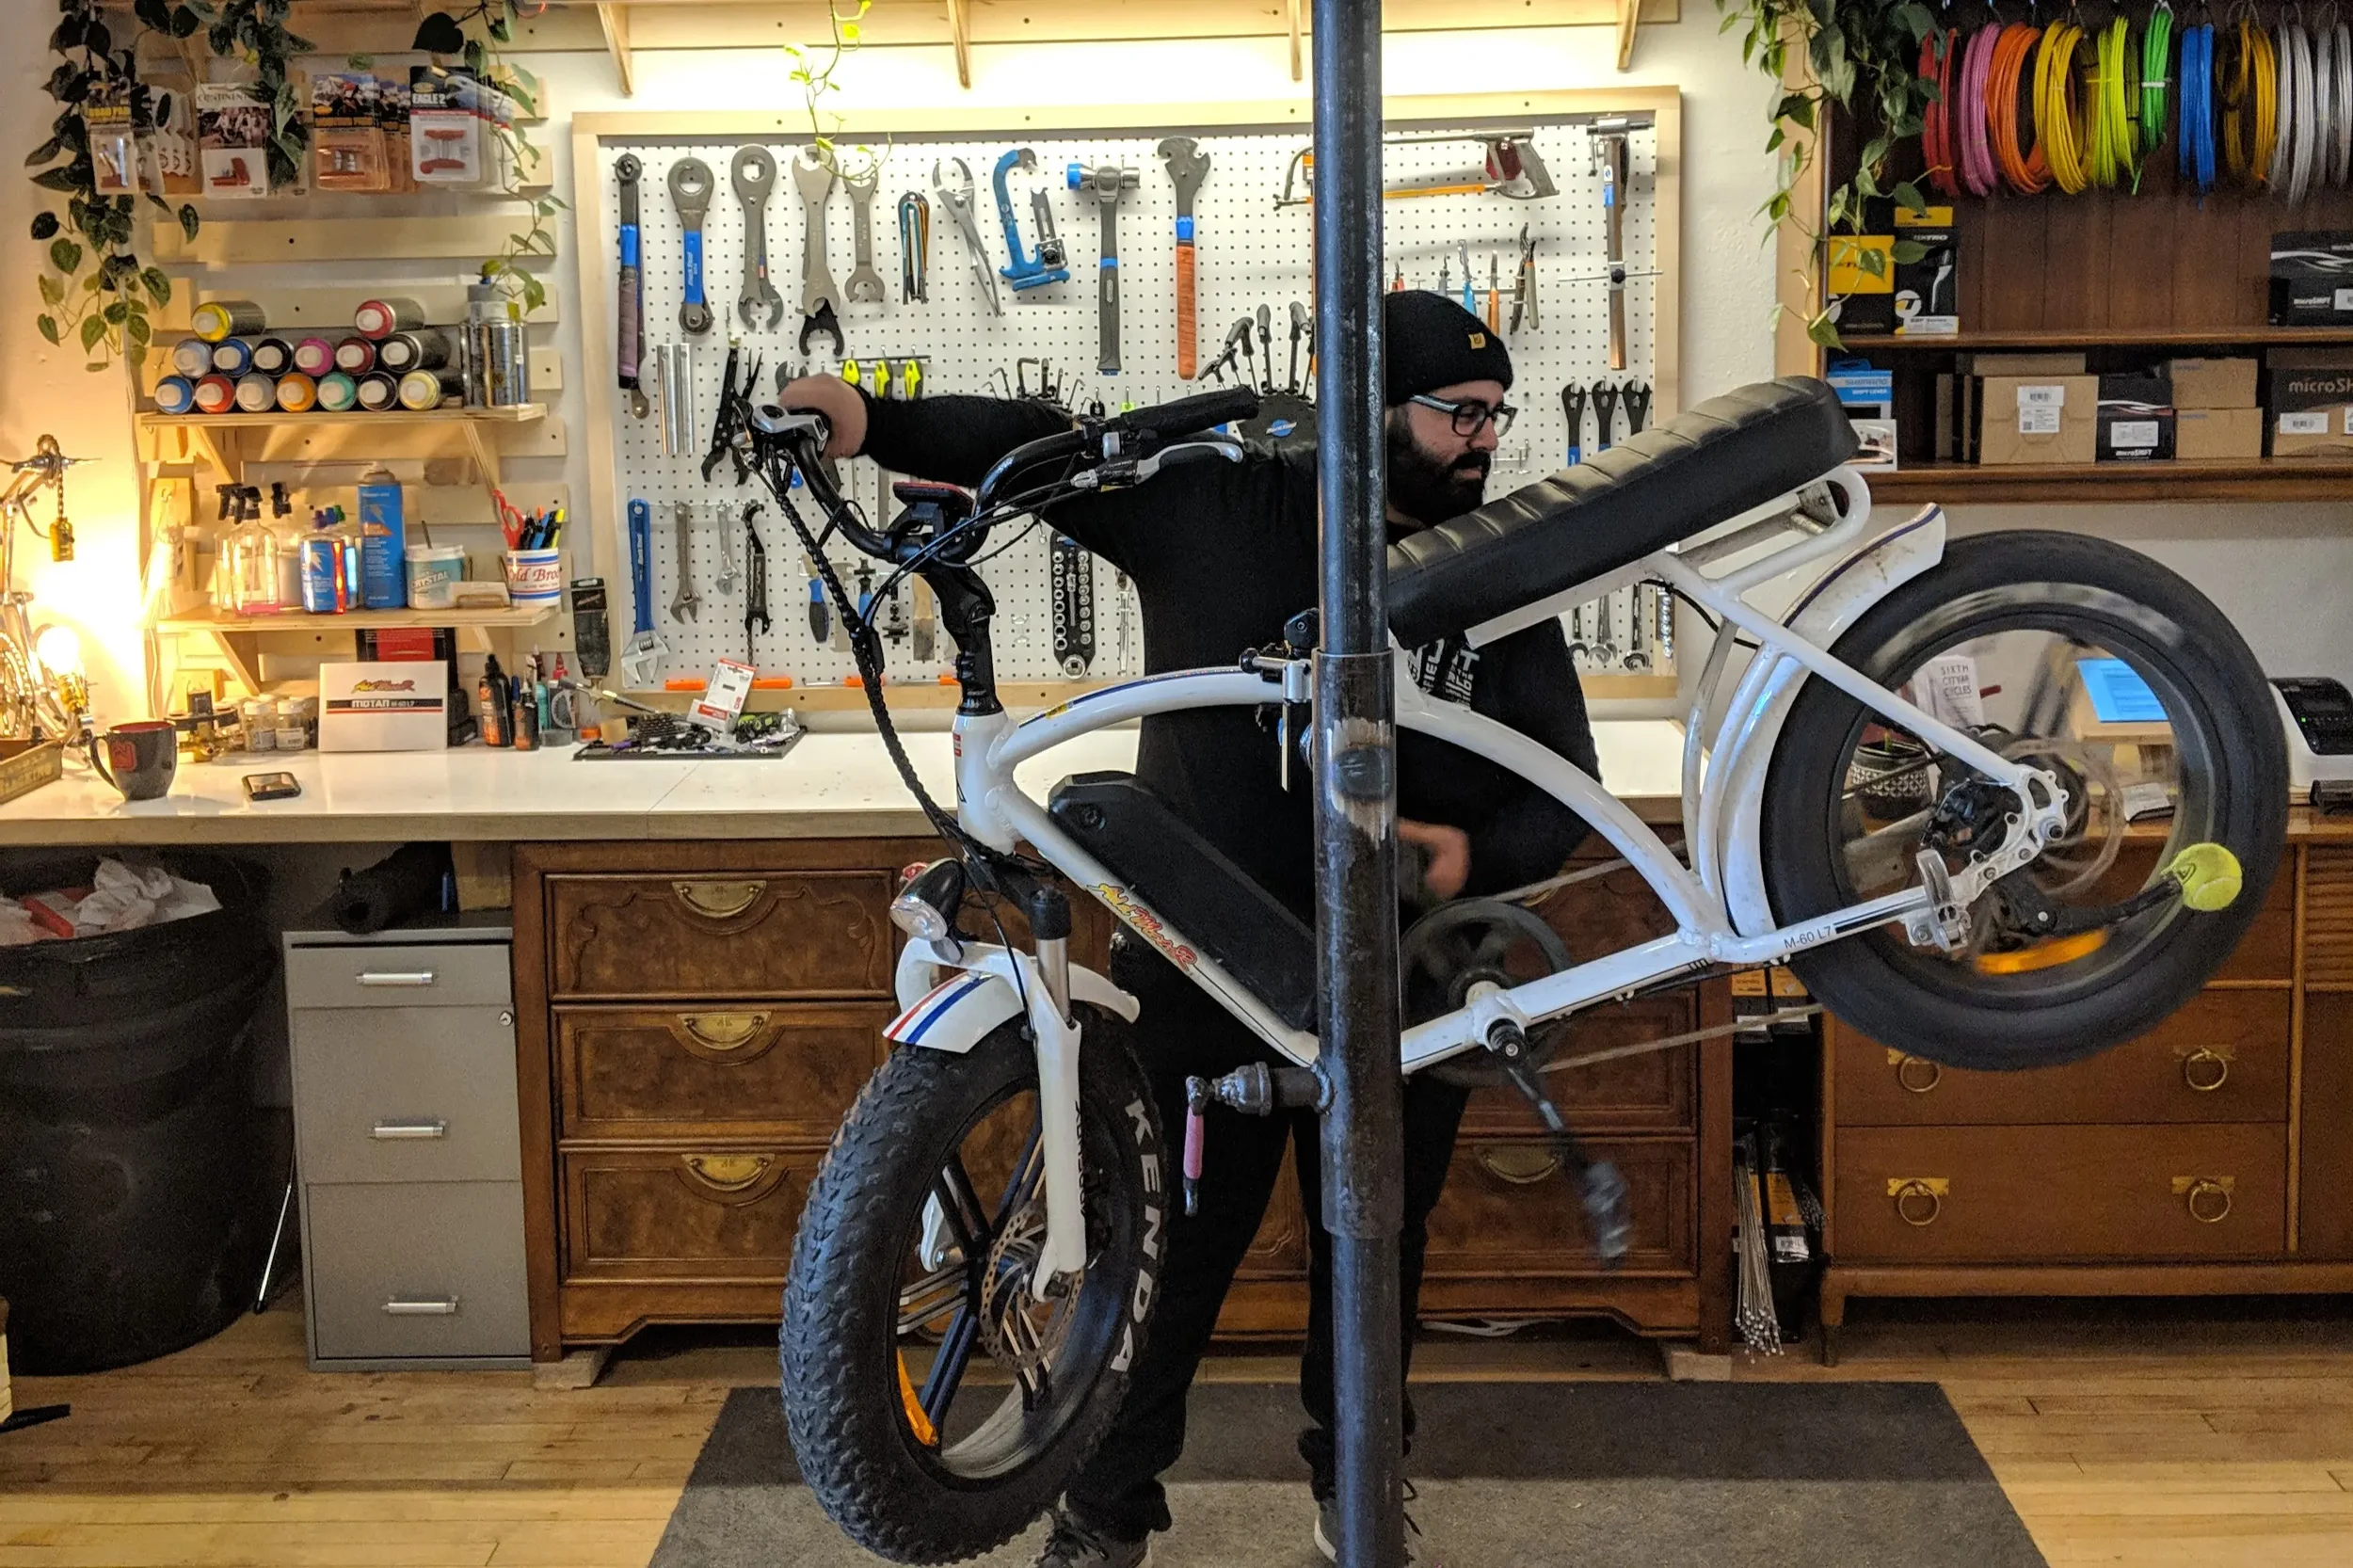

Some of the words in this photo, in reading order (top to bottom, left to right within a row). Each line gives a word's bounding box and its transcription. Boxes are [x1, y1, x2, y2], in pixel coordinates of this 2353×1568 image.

[1941, 664, 1969, 675] SIXTH
[1784, 931, 1815, 949] M-60
[1817, 925, 1832, 939] L7
[1111, 1098, 1160, 1372] KENDA
